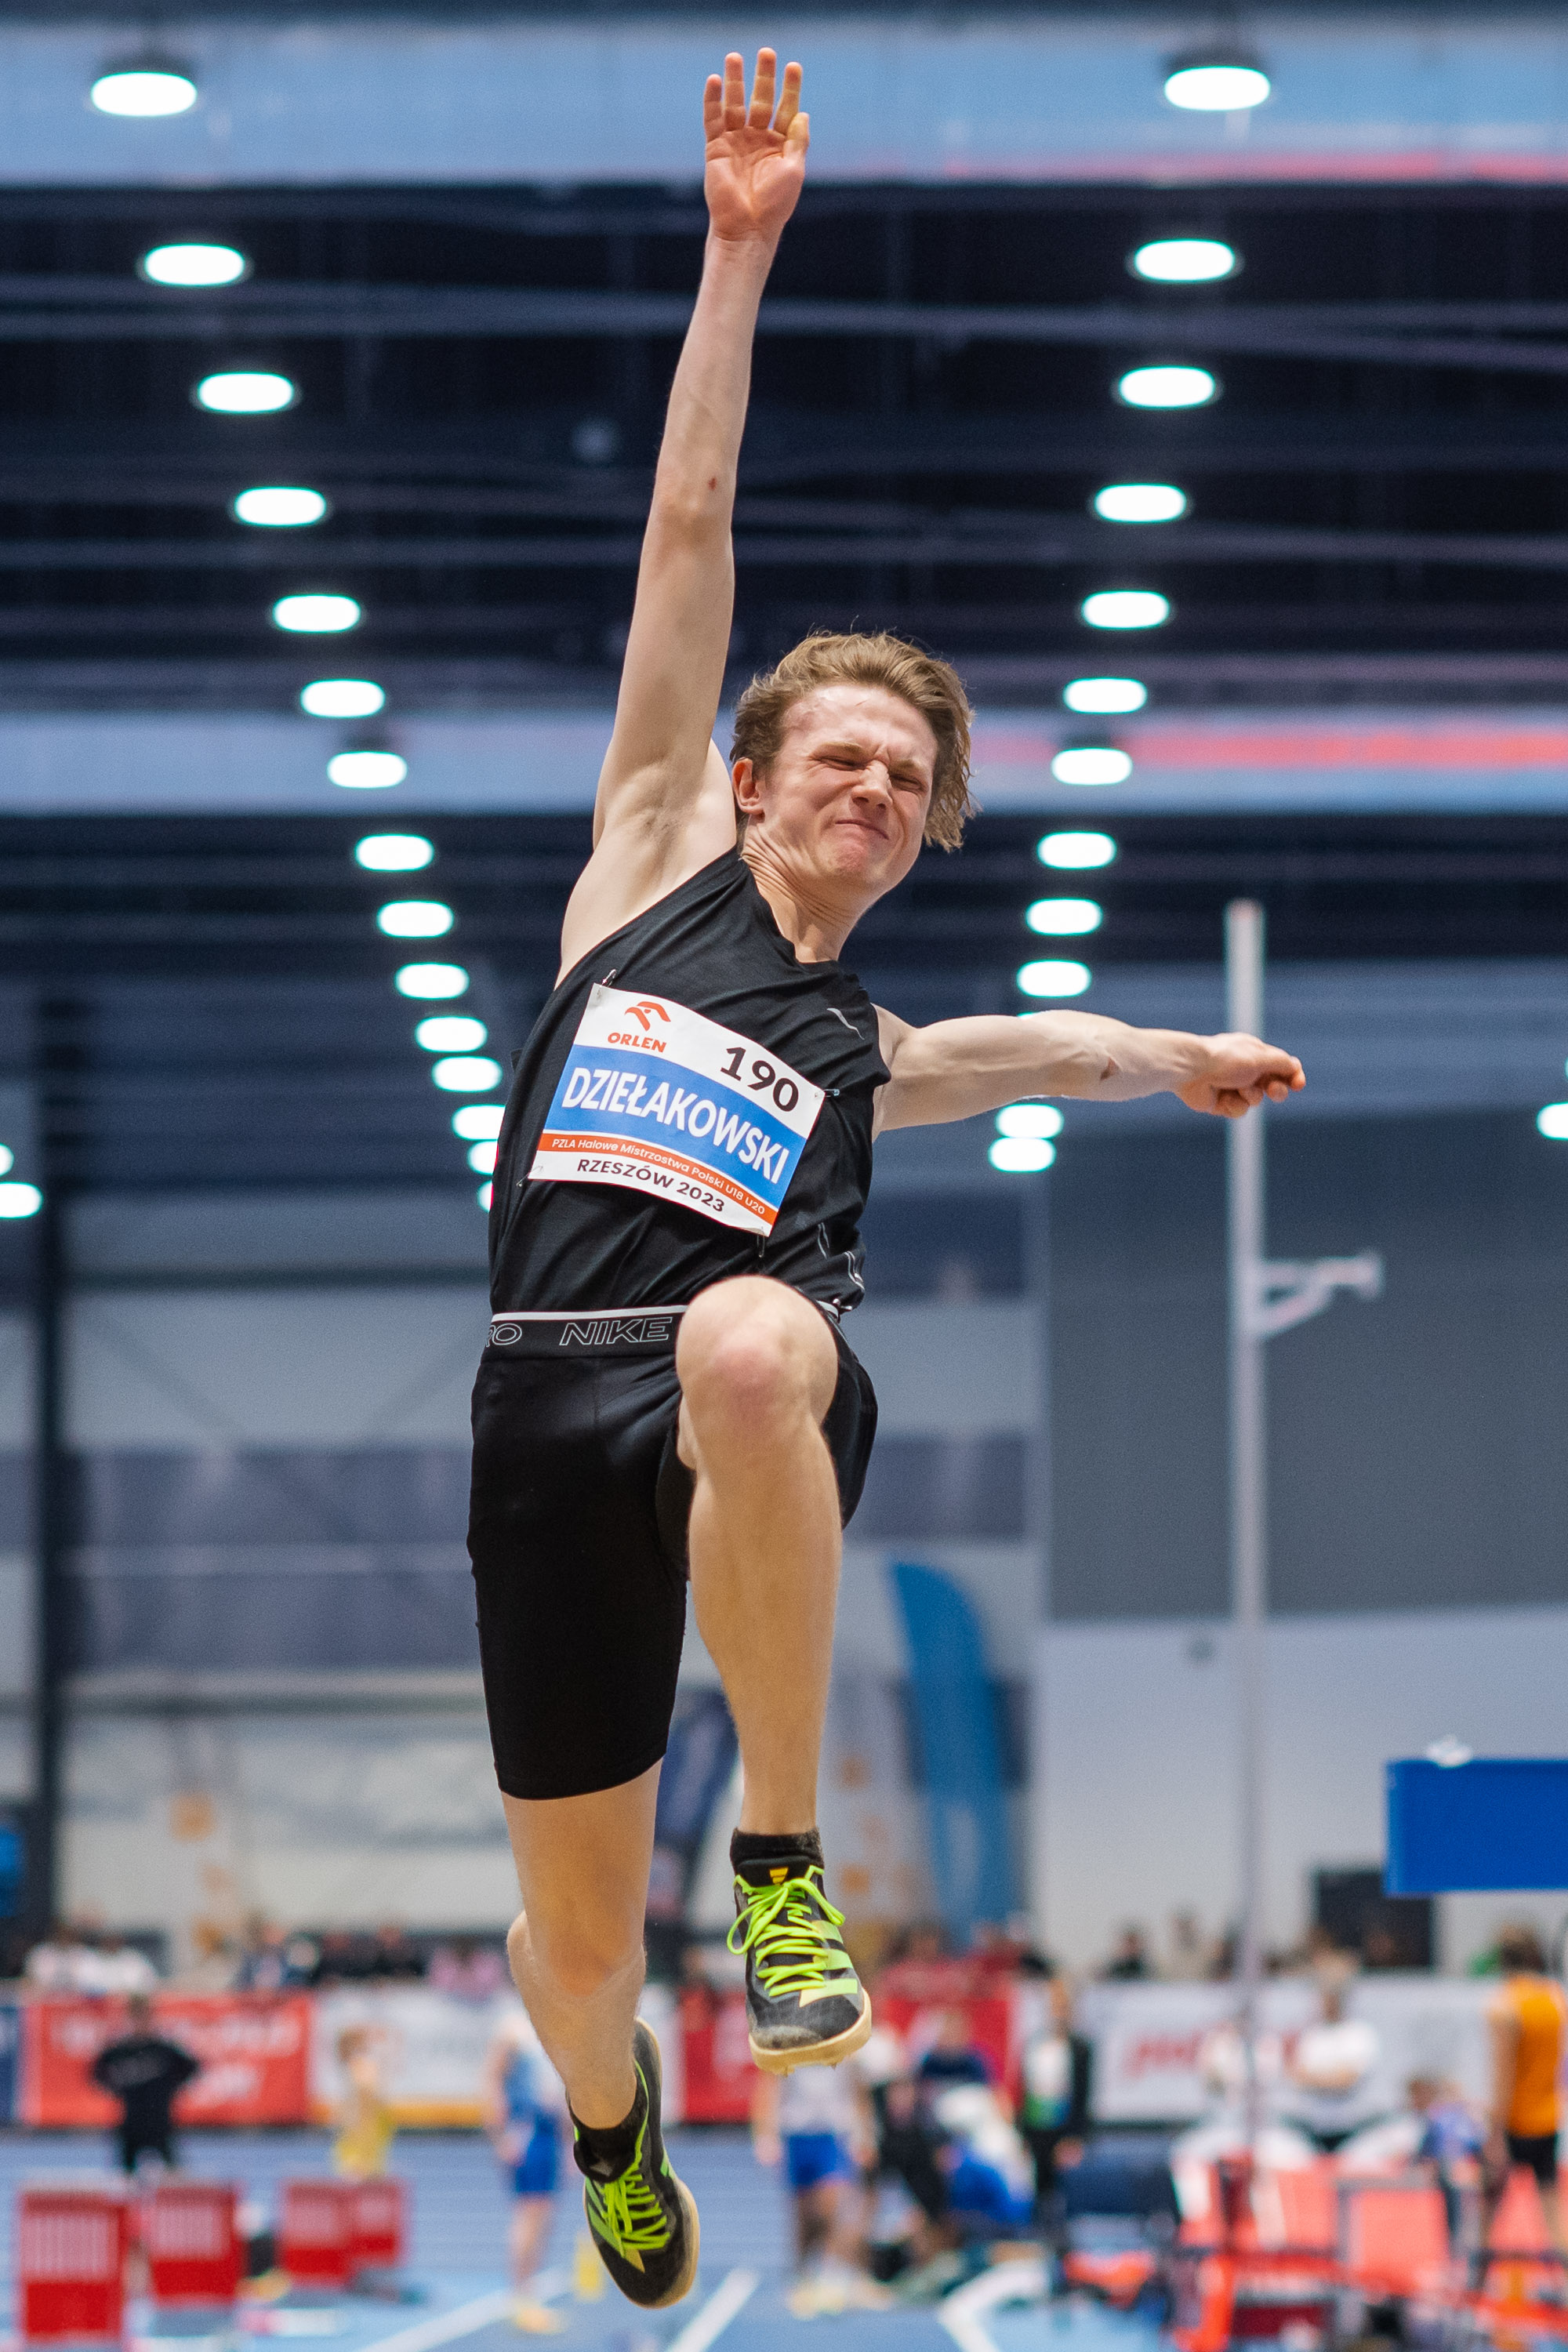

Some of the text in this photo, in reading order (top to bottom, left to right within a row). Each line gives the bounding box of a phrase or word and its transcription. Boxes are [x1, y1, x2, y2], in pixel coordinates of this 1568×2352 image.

[608, 1032, 666, 1052] ORLEN
[720, 1047, 799, 1112] 190
[561, 1067, 789, 1184] DZIEŁAKOWSKI
[552, 1138, 765, 1215] PZLA Halowe Mistrzostwa Polski U18 U20
[577, 1159, 725, 1212] RZESZÓW 2023
[559, 1316, 673, 1346] NIKE
